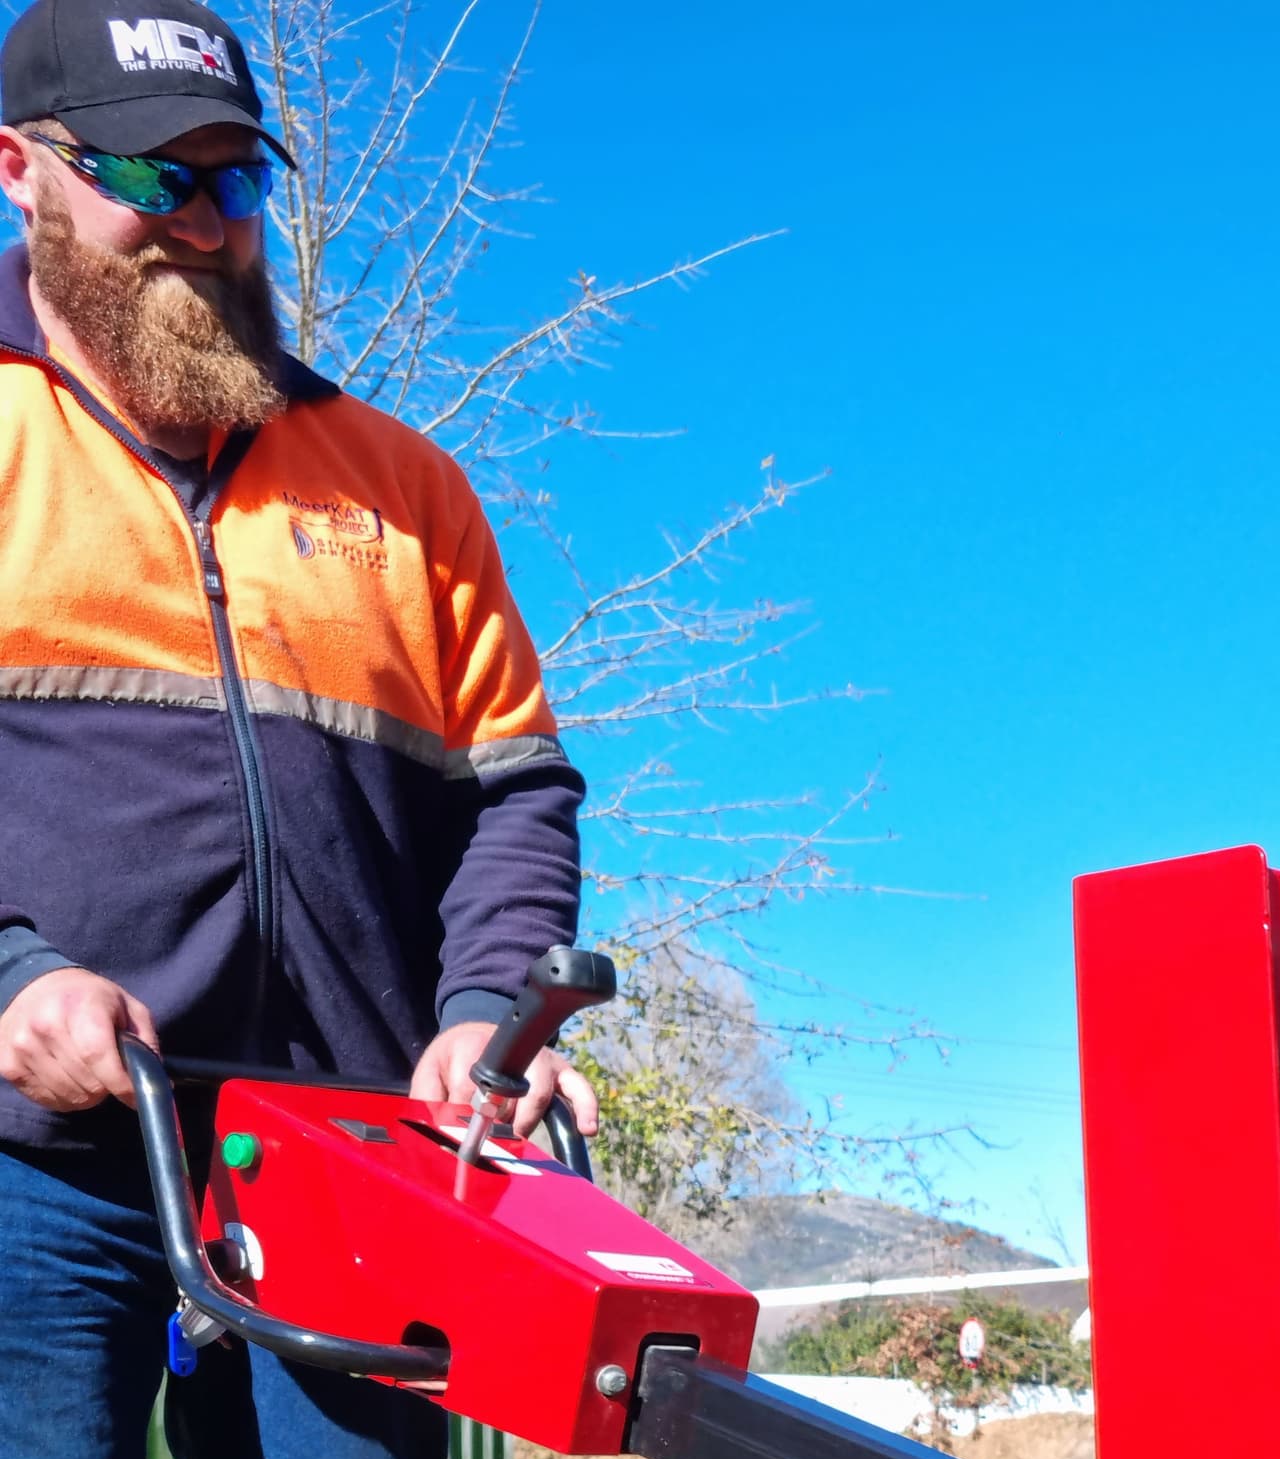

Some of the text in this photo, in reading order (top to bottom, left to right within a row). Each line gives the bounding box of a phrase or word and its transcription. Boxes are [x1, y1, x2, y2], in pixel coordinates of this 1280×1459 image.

[108, 19, 235, 76] MCM
[120, 61, 146, 72] THE
[150, 60, 200, 73] FUTURE
[202, 66, 214, 76] IS
